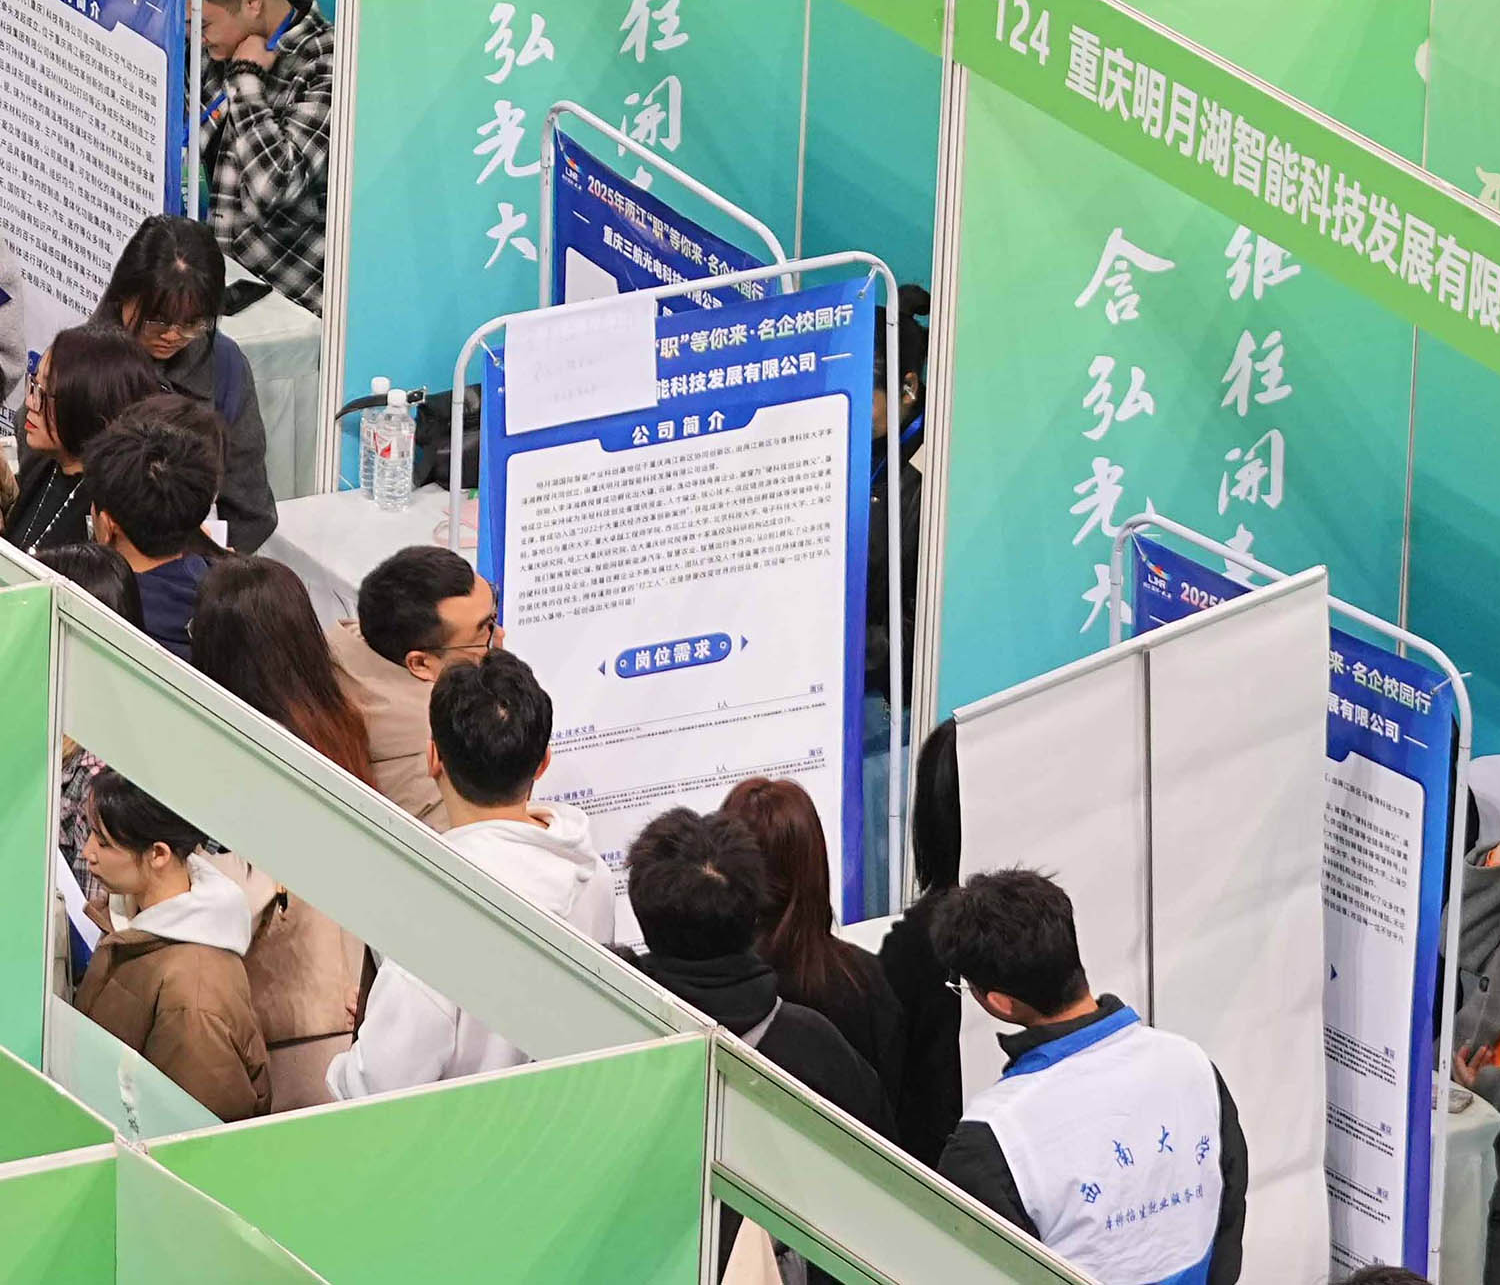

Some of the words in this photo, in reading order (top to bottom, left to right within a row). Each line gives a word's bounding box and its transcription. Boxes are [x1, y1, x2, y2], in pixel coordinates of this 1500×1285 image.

[632, 410, 726, 446] 公司简介
[635, 640, 711, 674] 岗位需求
